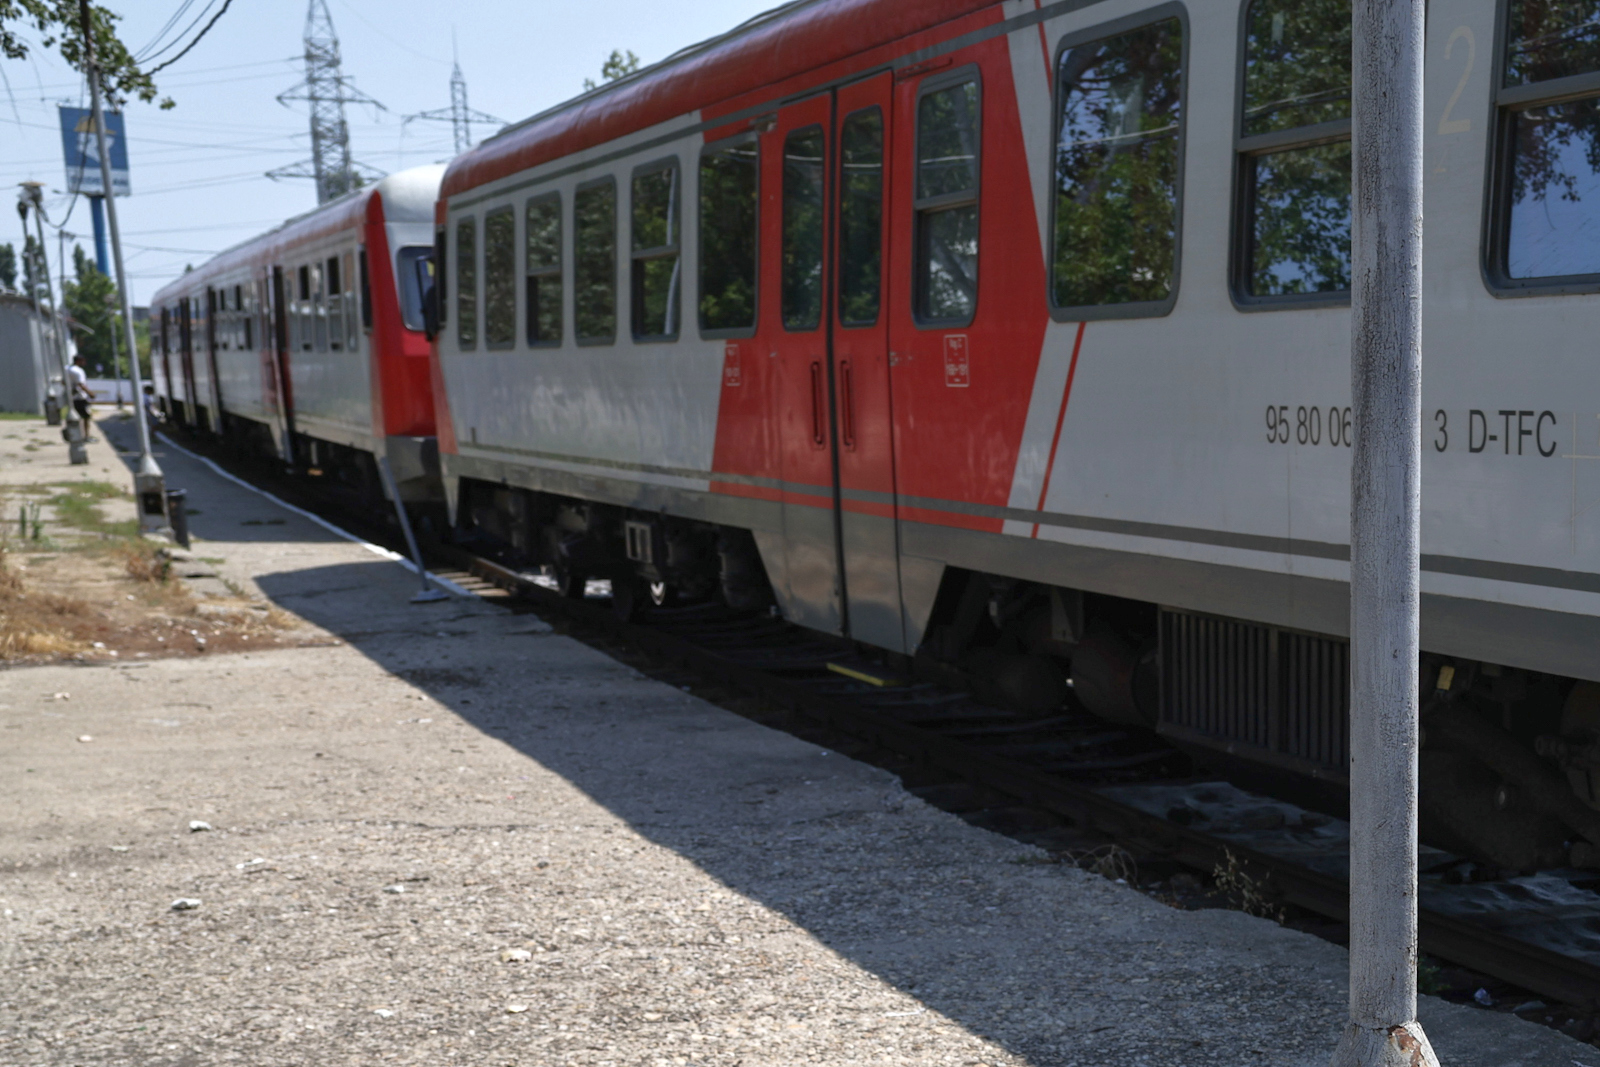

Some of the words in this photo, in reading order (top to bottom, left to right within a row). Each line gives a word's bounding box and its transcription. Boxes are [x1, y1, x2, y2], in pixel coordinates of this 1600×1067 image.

[1265, 404, 1290, 445] 95
[1296, 405, 1321, 446] 80
[1469, 409, 1557, 458] D-TFC
